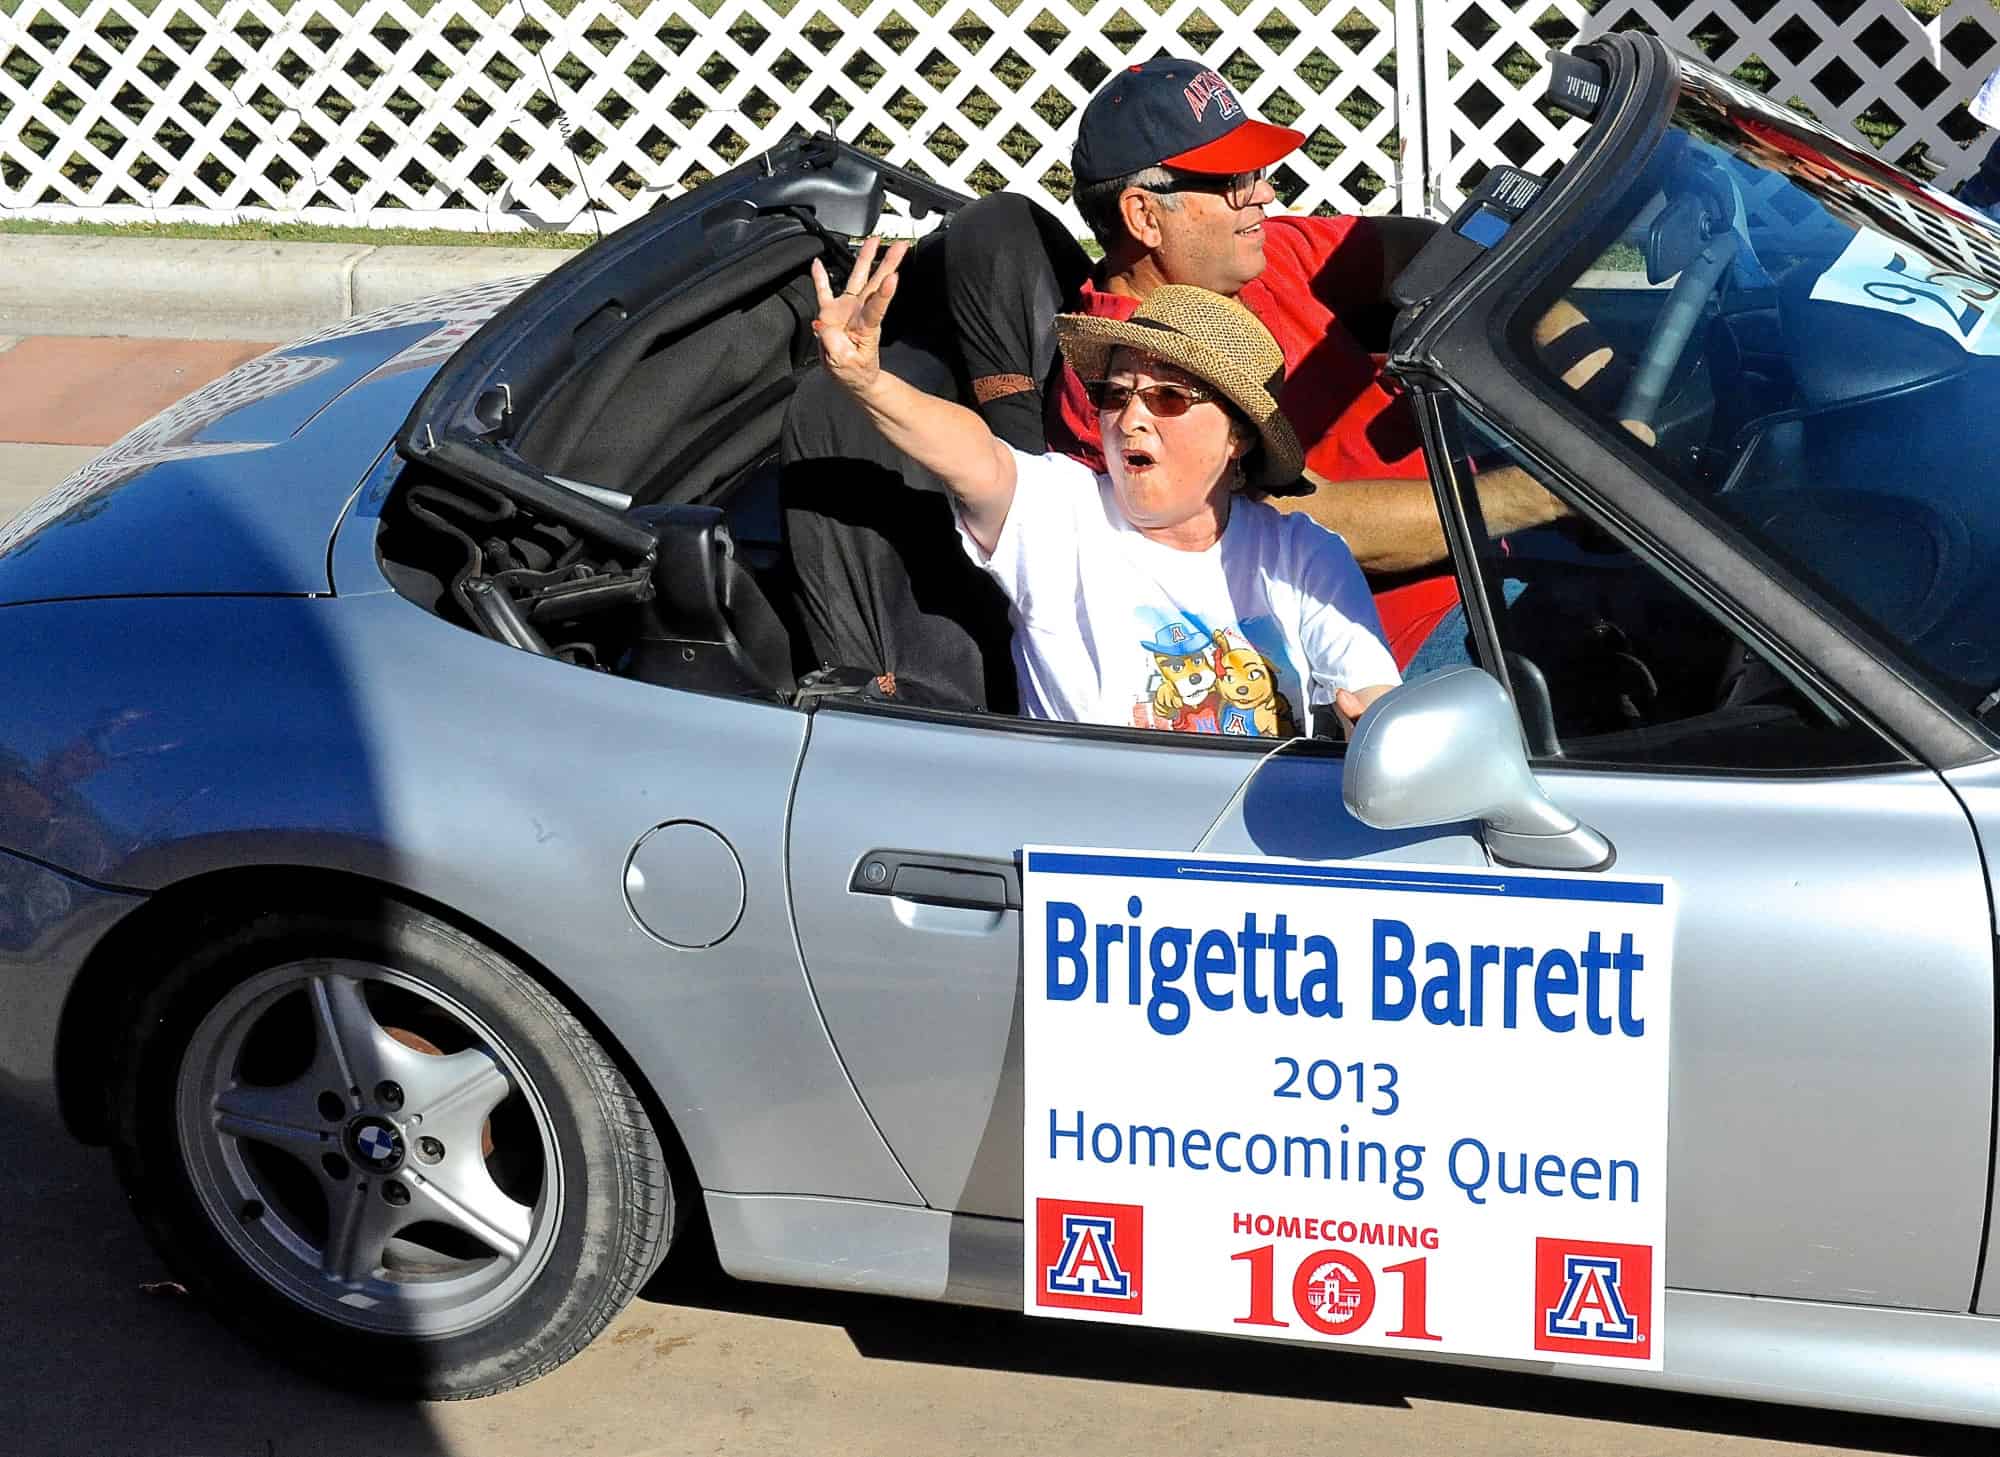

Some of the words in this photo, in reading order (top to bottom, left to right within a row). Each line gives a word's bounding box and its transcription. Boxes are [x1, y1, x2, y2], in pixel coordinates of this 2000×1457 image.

[1171, 626, 1186, 643] A
[1225, 713, 1249, 736] A
[1045, 895, 1344, 1036] Brigetta
[1371, 918, 1645, 1038] Barrett
[1273, 1056, 1400, 1117] 2013
[1049, 1108, 1425, 1200] Homecoming
[1447, 1137, 1640, 1205] Queen
[1047, 1214, 1131, 1300] A
[1232, 1212, 1440, 1250] HOMECOMING
[1231, 1244, 1443, 1342] 101
[1545, 1253, 1639, 1344] A
